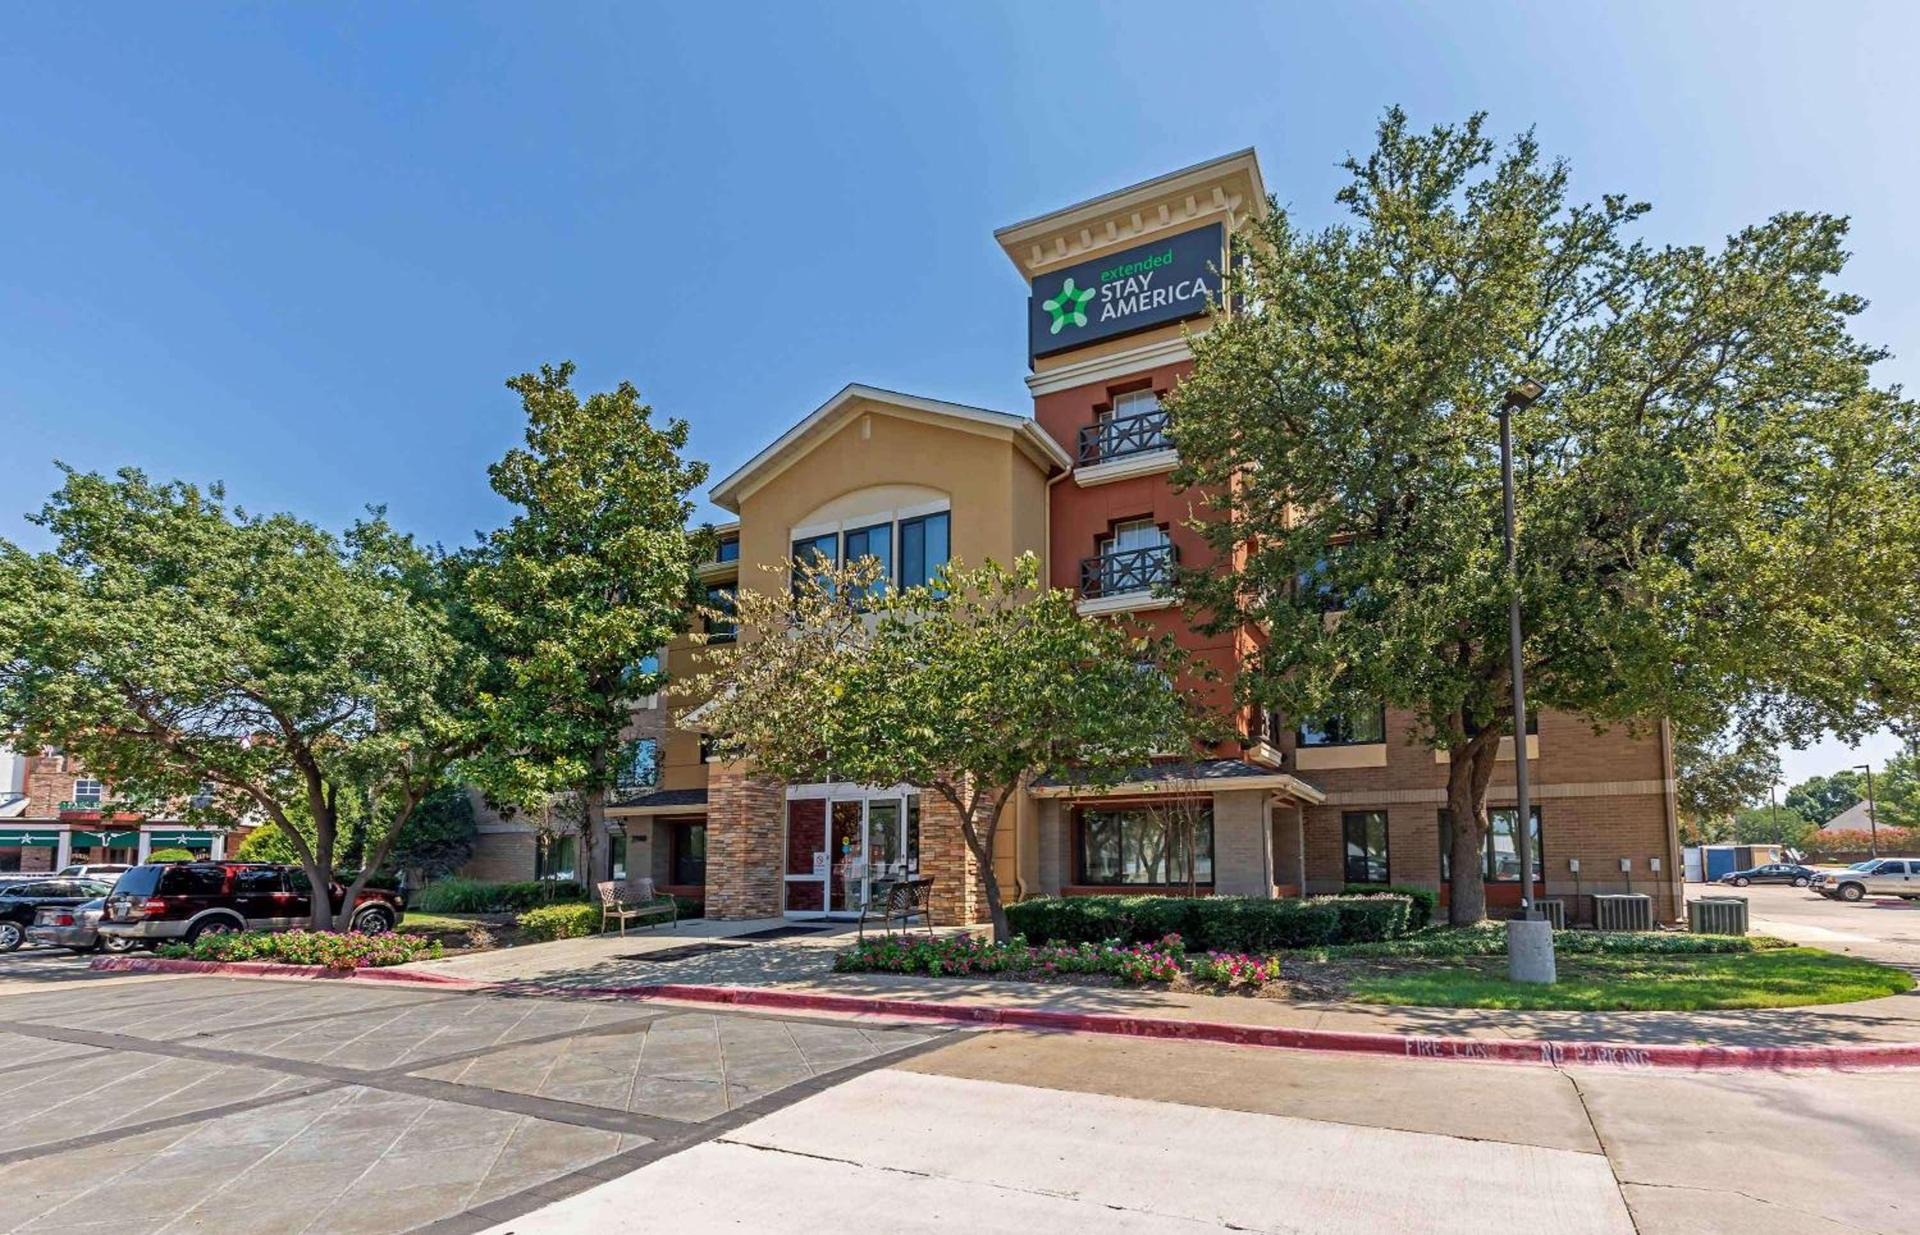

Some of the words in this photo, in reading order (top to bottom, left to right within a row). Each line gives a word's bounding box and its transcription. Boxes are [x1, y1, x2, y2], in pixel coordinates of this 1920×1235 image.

[1101, 249, 1172, 281] extended
[1100, 278, 1207, 322] AMERICA
[1101, 271, 1153, 302] STAY
[1406, 1040, 1443, 1057] FIRE
[1453, 1042, 1498, 1059] LAN
[1541, 1044, 1564, 1063] NO
[1575, 1045, 1650, 1066] PARKING
